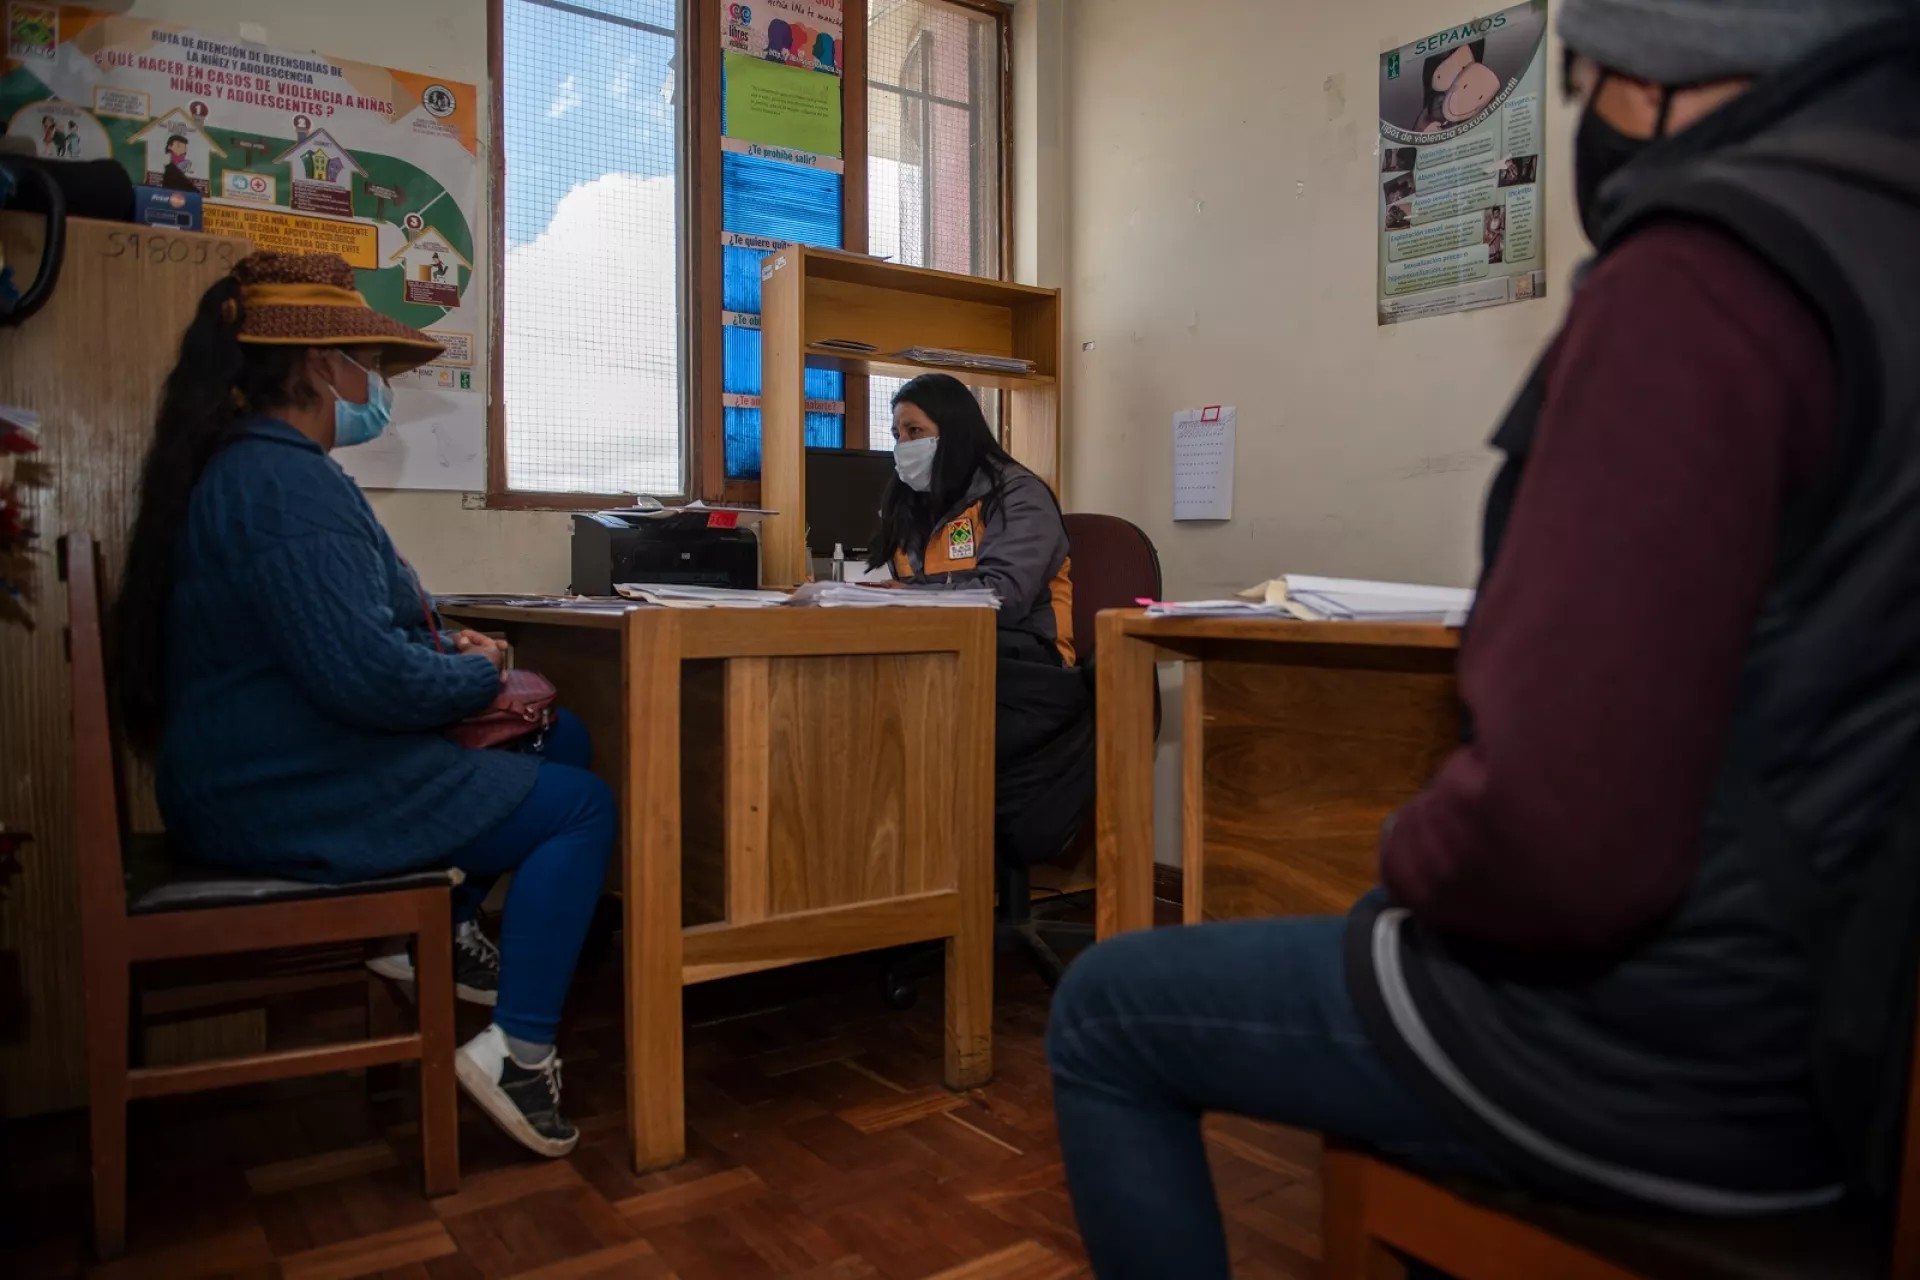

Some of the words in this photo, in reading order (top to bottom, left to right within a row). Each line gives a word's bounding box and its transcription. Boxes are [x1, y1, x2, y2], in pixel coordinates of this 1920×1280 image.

[729, 25, 748, 42] libres
[1414, 13, 1507, 54] SEPAMOS
[152, 30, 179, 46] RUTA
[181, 35, 194, 49] DE
[196, 39, 246, 60] ATENCIÓN
[249, 50, 261, 64] DE
[263, 53, 329, 76] DEFENSORÍAS
[331, 65, 343, 78] DE
[187, 51, 199, 63] LA
[201, 53, 230, 69] NIÑEZ
[231, 59, 238, 70] Y
[240, 61, 314, 84] ADOLESCENCIA
[138, 55, 184, 76] HACER
[187, 65, 203, 79] EN
[207, 69, 252, 90] CASOS
[255, 78, 271, 92] DE
[277, 81, 343, 105] VIOLENCIA
[346, 94, 354, 108] A
[170, 77, 212, 97] NIÑOS
[215, 85, 224, 99] Y
[227, 88, 323, 117] ADOLESCENTES
[326, 105, 335, 119] ?
[1381, 121, 1400, 137] Tipos
[1401, 132, 1413, 142] de
[1414, 130, 1456, 144] violencia
[1457, 108, 1489, 134] sexual
[1489, 77, 1518, 112] infantil
[748, 143, 762, 156] ¿Te
[795, 154, 817, 165] salir?
[260, 216, 270, 224] LA
[321, 222, 369, 237] ADOLESCENTE
[294, 239, 314, 248] PARA
[315, 241, 329, 251] QUE
[331, 243, 341, 252] SE
[341, 245, 361, 255] EVITE
[729, 234, 743, 246] ¿Te
[745, 237, 770, 248] quiere
[733, 314, 747, 326] ¿Te
[735, 396, 749, 409] ¿Te
